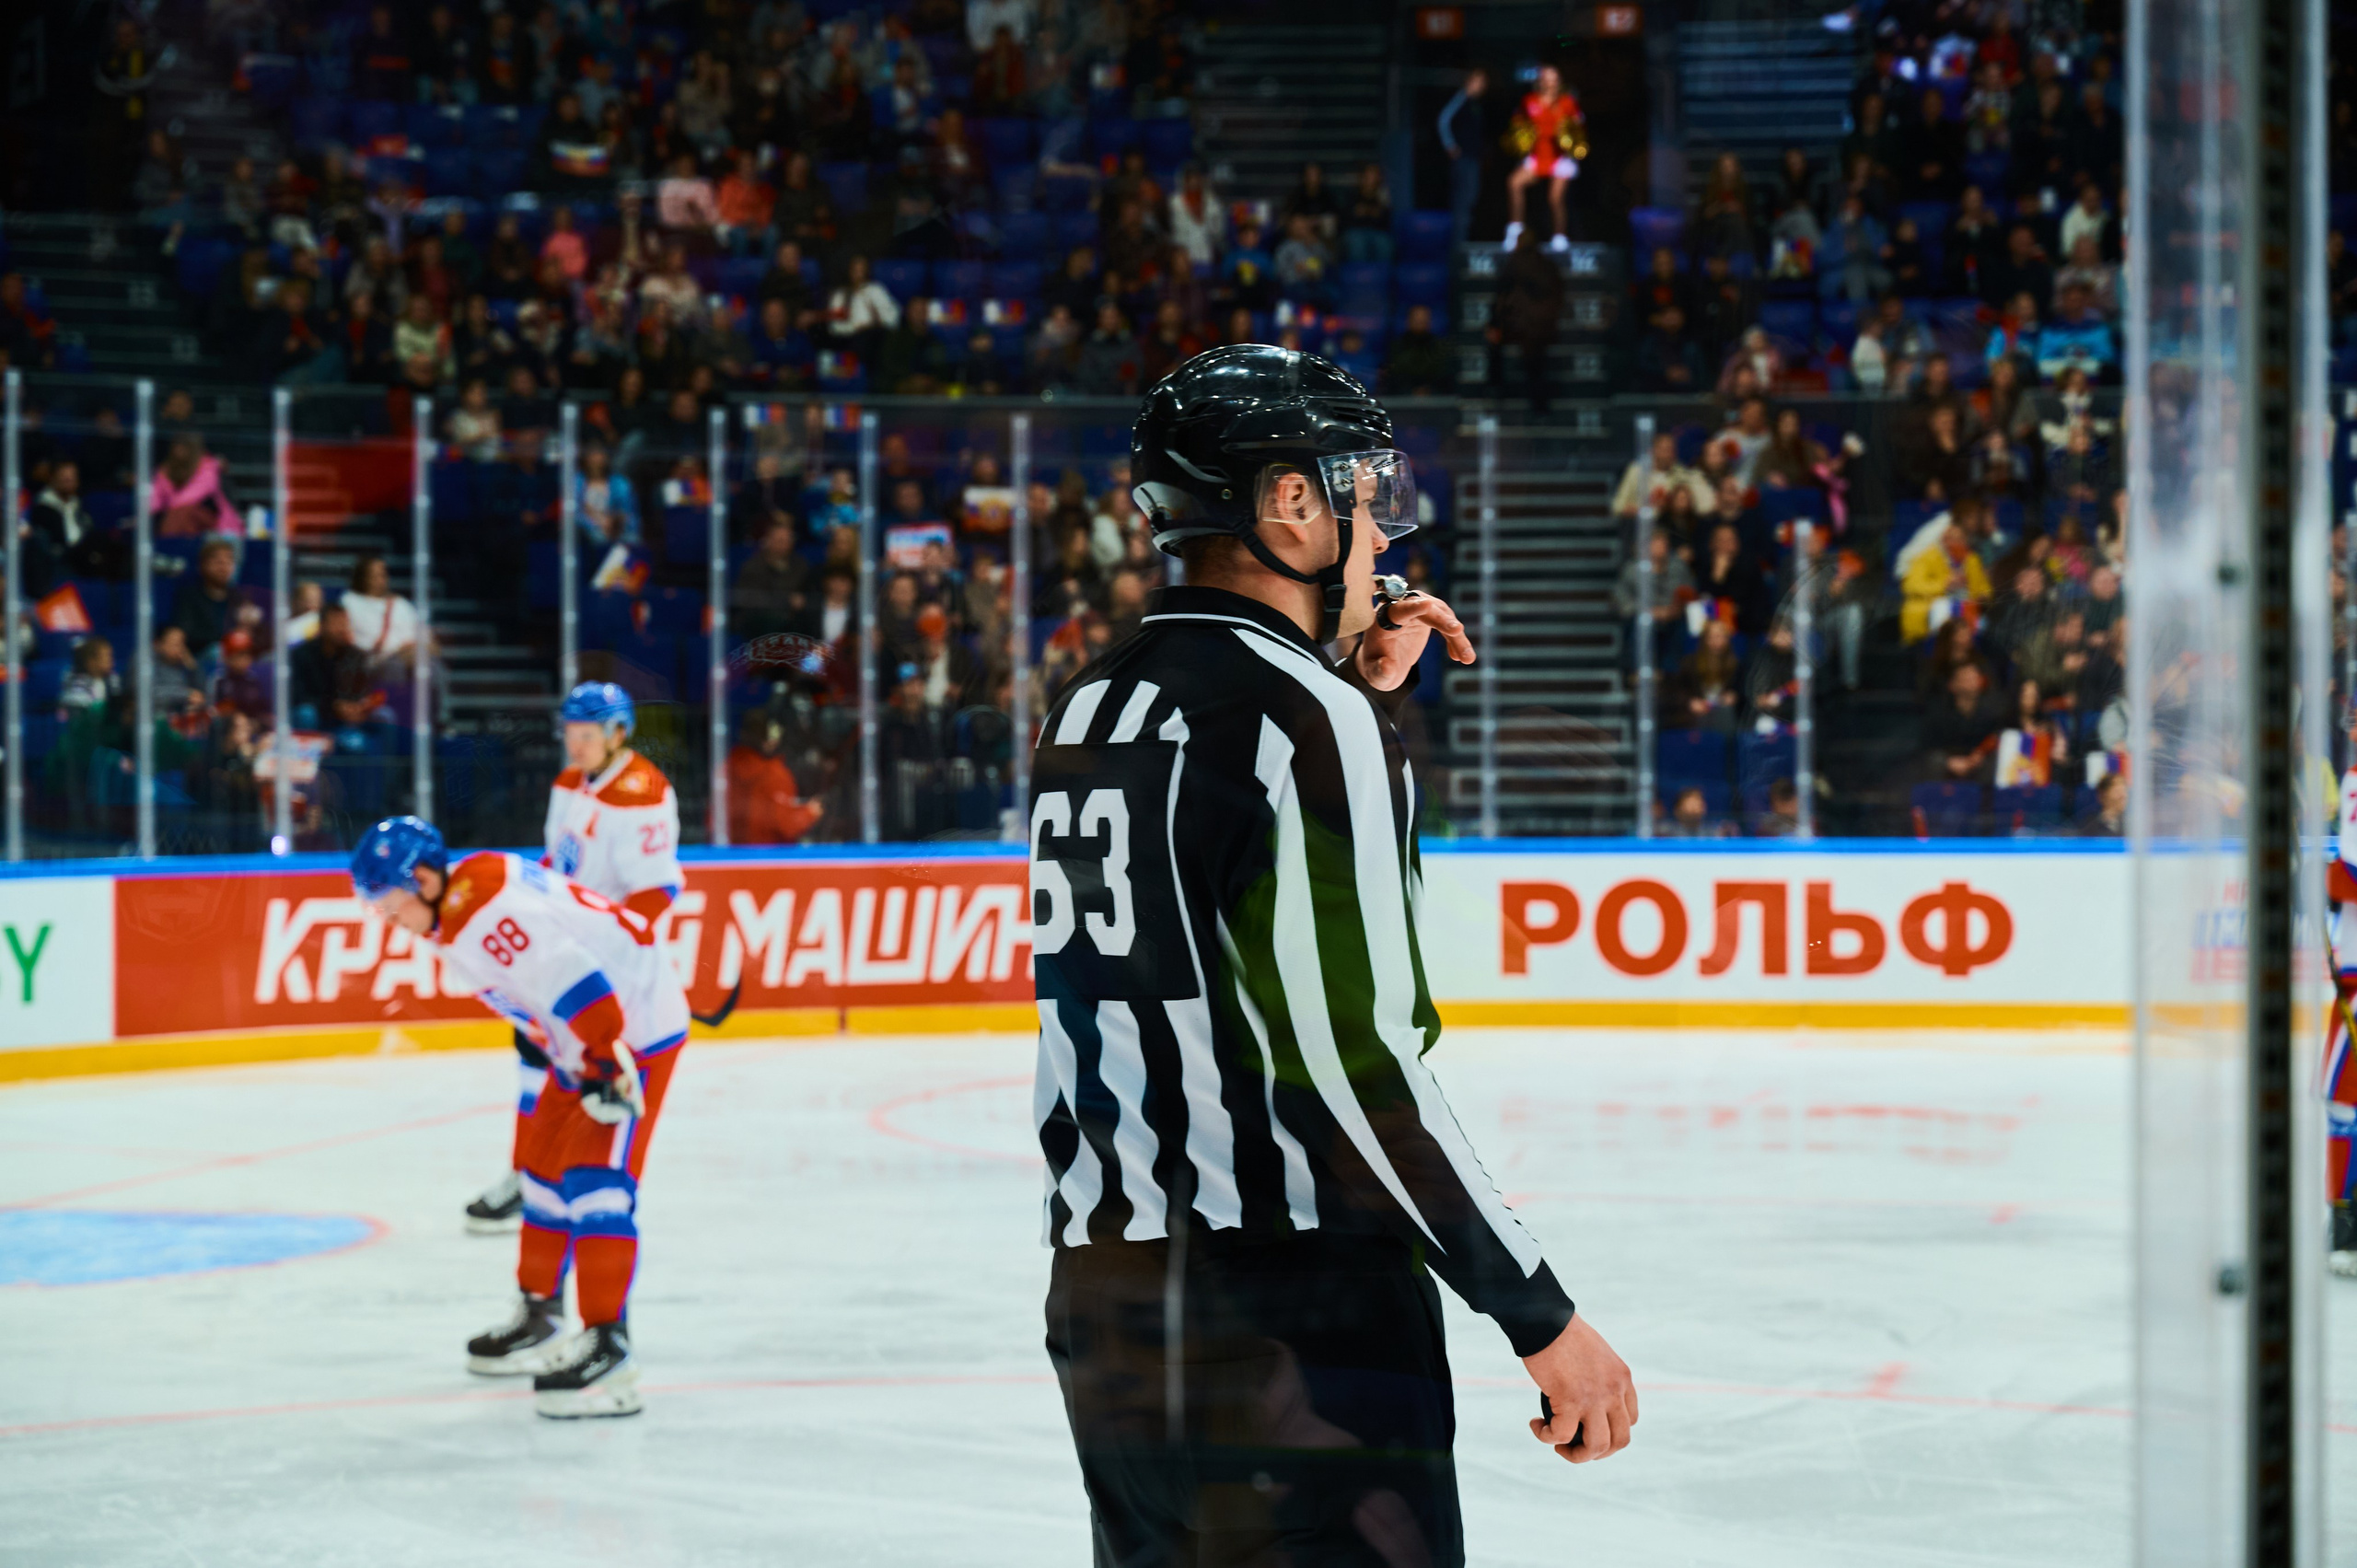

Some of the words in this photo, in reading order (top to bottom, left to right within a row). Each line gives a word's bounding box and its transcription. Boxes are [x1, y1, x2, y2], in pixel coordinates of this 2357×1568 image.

[1029, 788, 1137, 957] 63
[482, 917, 531, 967] 88
[717, 884, 1034, 991] МАШИН
[1500, 877, 2015, 978] РОЛЬФ
